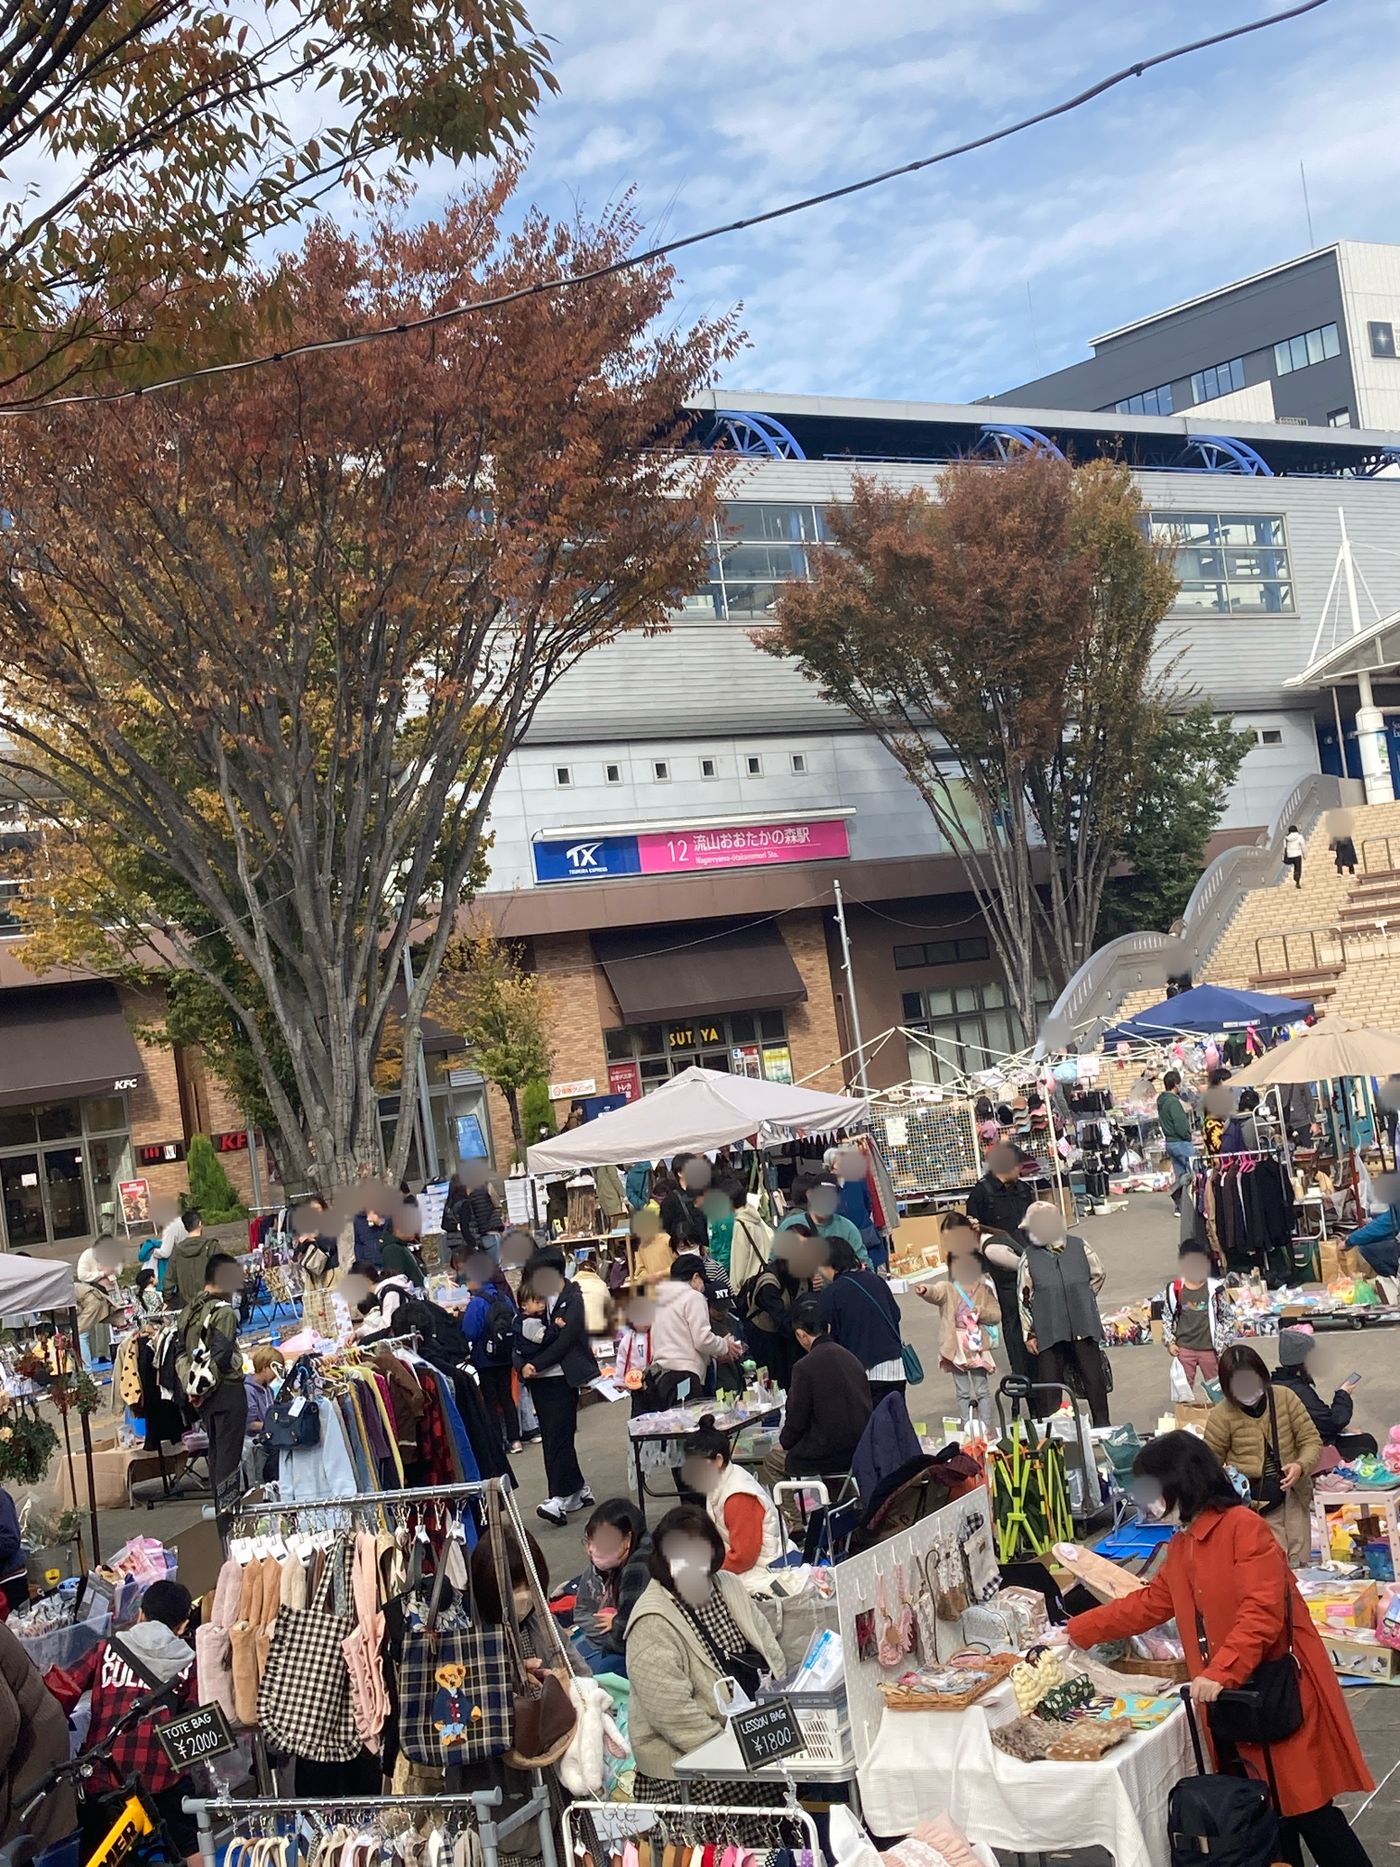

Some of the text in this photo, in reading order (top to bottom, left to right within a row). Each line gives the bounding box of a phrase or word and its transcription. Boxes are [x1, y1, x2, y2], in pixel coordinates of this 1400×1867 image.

[566, 842, 603, 867] TX
[667, 827, 810, 862] 12 流山おおたかの森駅
[114, 1078, 137, 1090] KFC
[219, 1131, 252, 1152] KF
[715, 1288, 729, 1299] NY
[162, 1713, 212, 1740] TOTE BAG
[740, 1709, 787, 1735] LESSON BAG
